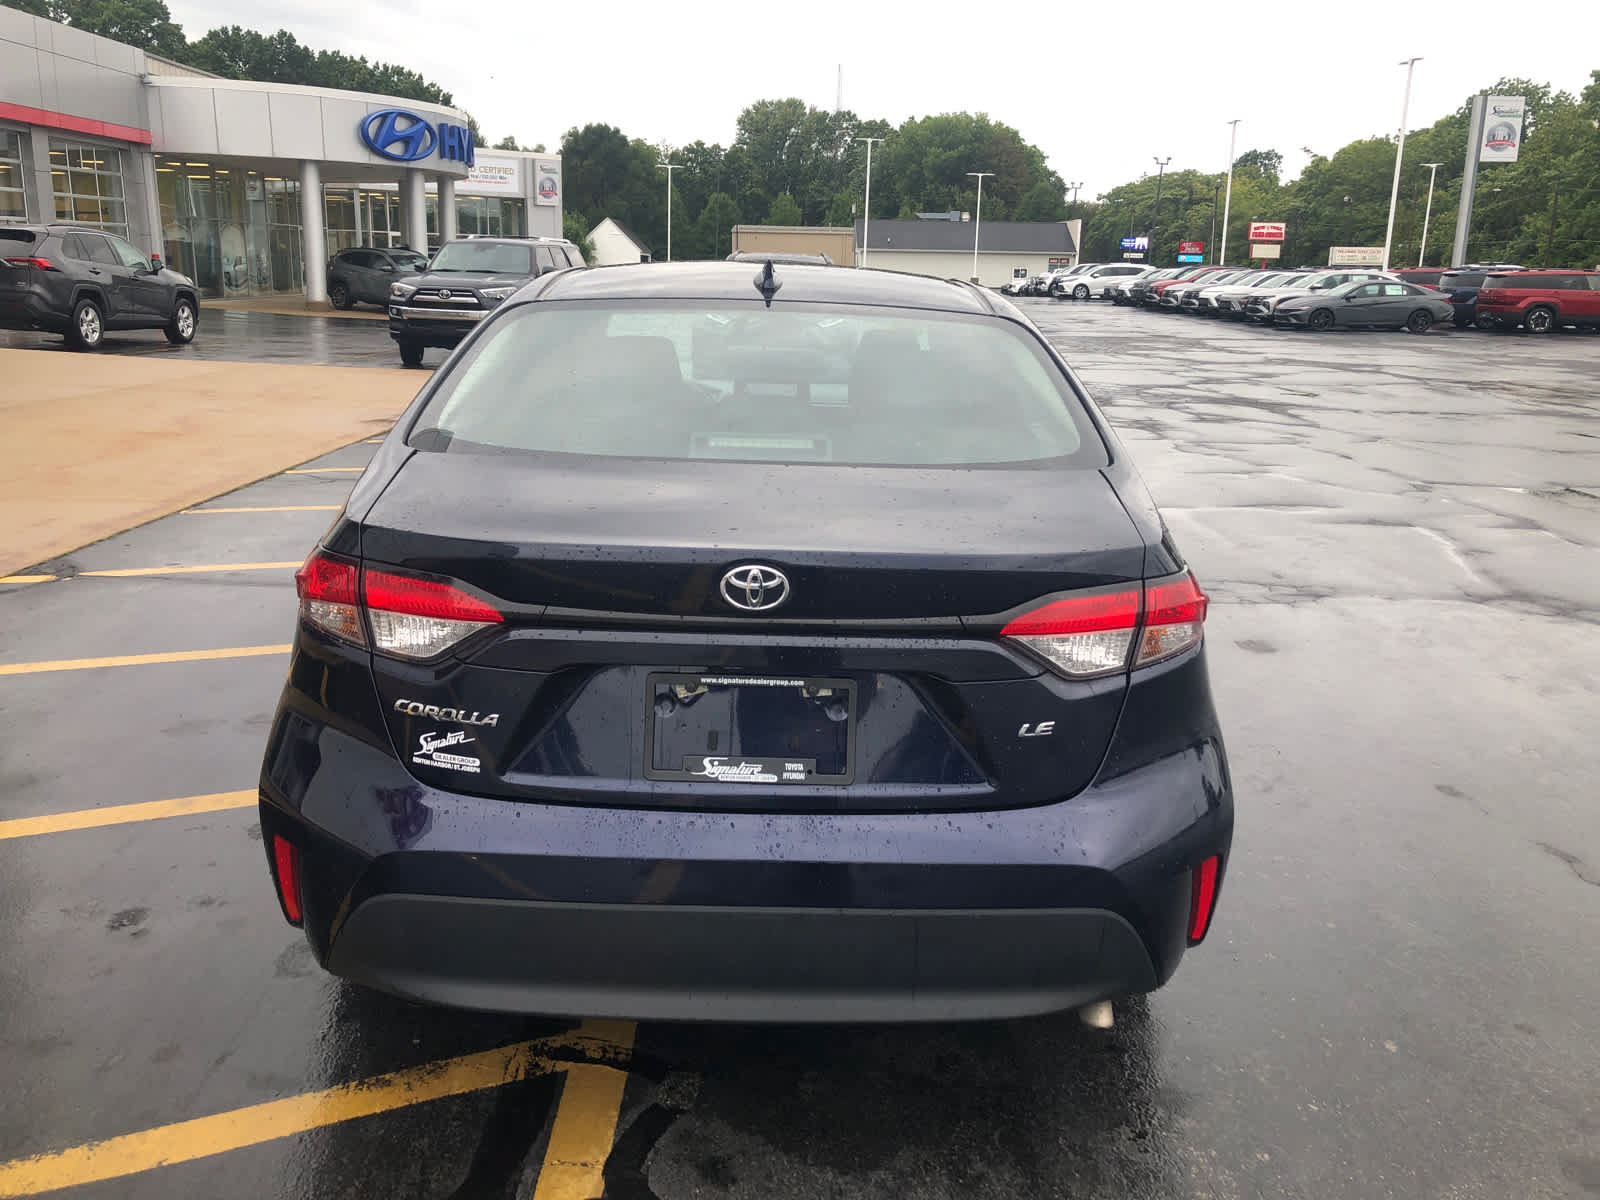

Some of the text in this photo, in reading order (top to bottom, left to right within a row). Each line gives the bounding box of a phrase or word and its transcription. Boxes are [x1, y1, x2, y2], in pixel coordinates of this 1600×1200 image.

[394, 699, 500, 727] COROLLA
[1018, 721, 1056, 737] LE
[414, 731, 476, 756] Signature
[690, 757, 763, 778] Signature
[782, 772, 806, 780] HYUNDAI
[785, 763, 804, 771] TOYOTA
